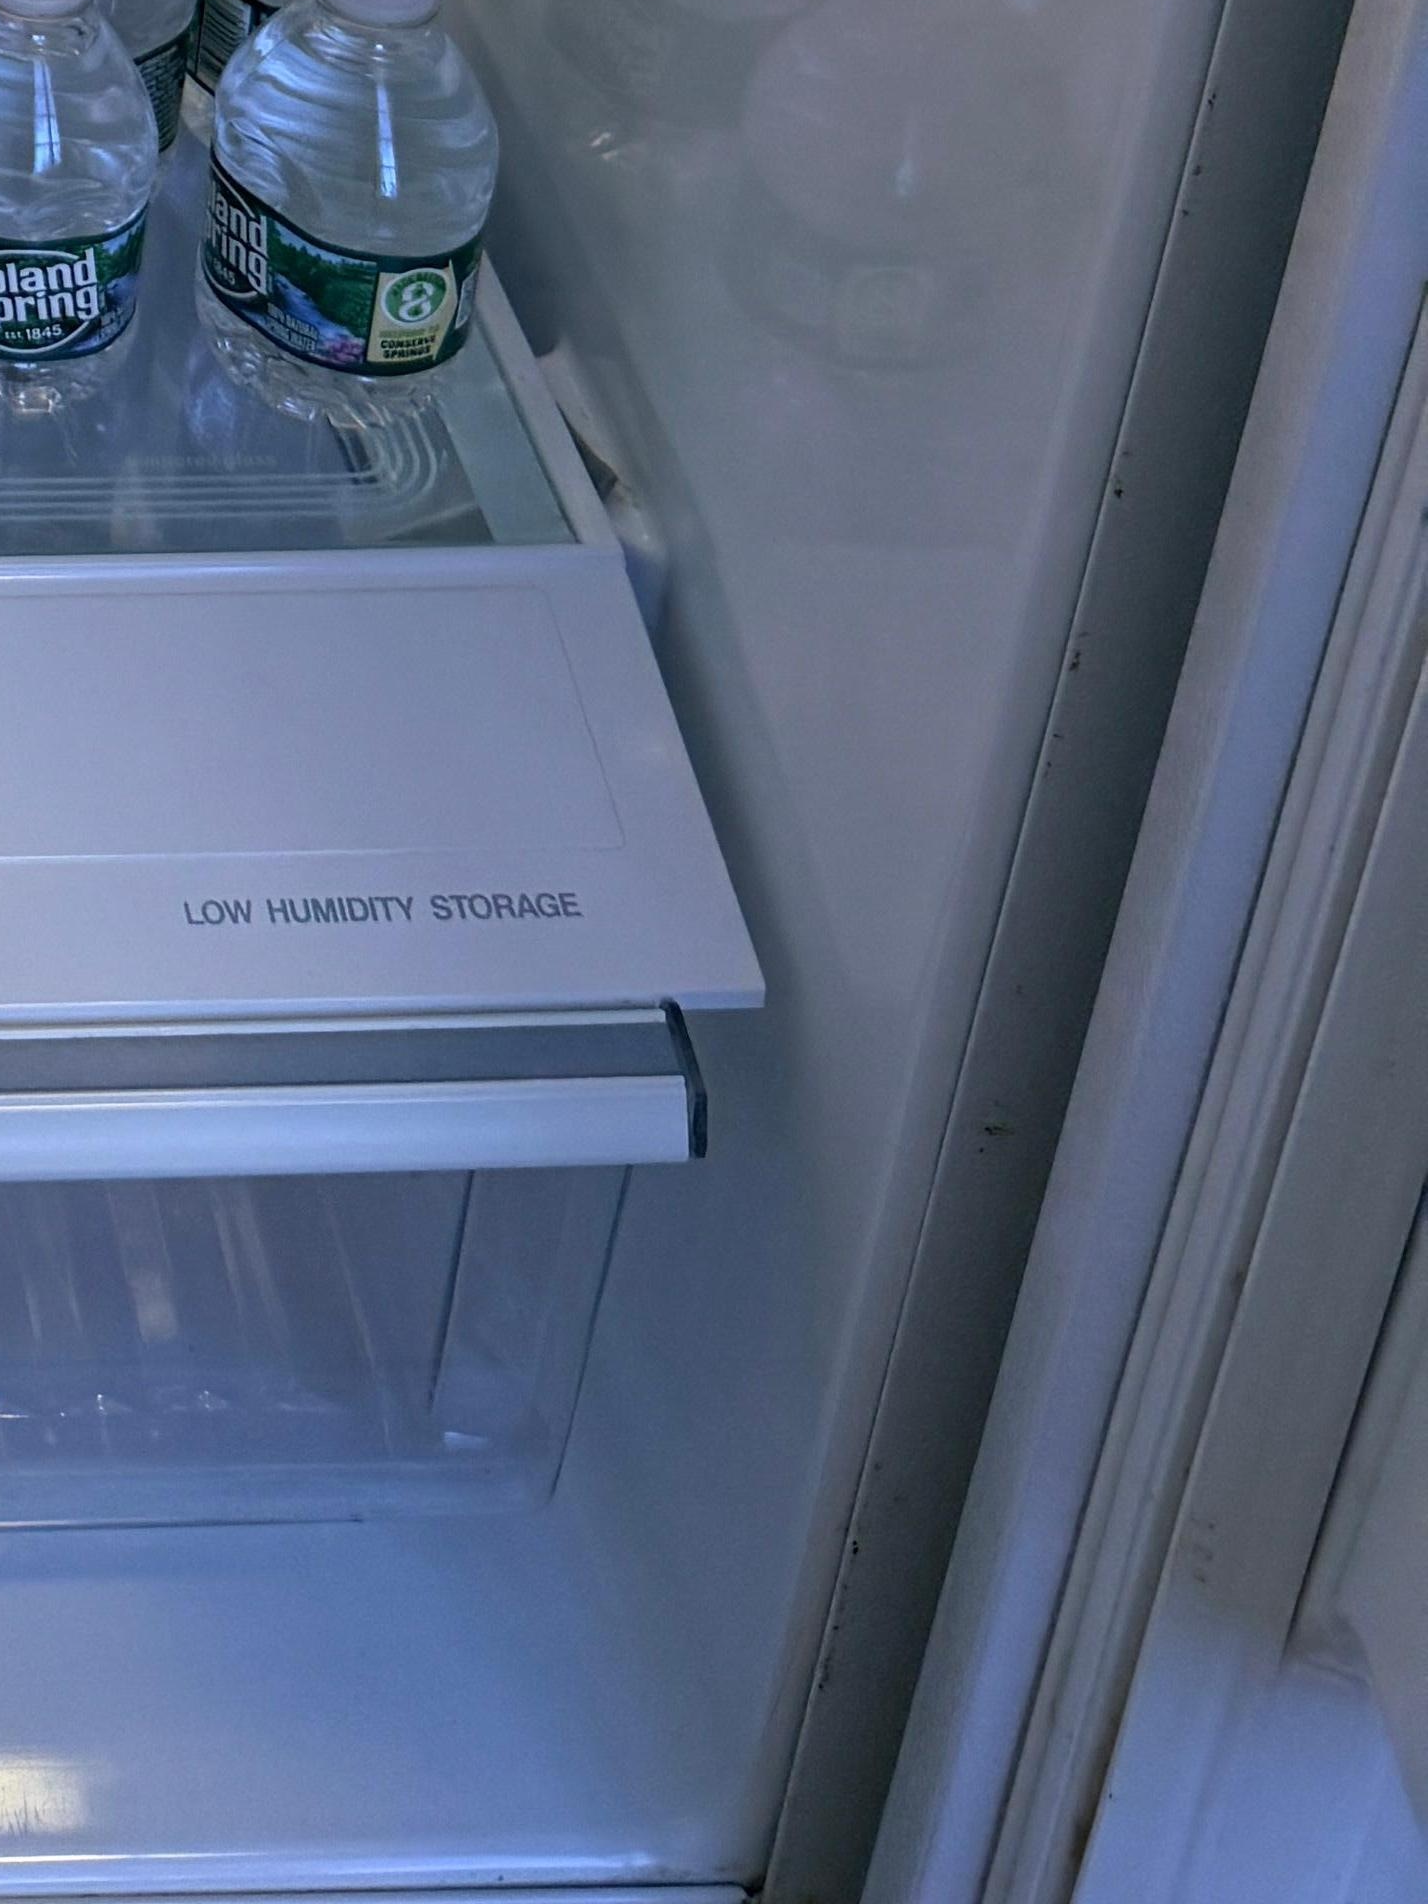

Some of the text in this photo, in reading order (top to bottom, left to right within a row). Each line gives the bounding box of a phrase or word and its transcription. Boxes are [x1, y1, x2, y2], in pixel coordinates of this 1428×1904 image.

[25, 323, 63, 341] 1845
[184, 892, 584, 925] LOW HUMIDITY STORAGE
